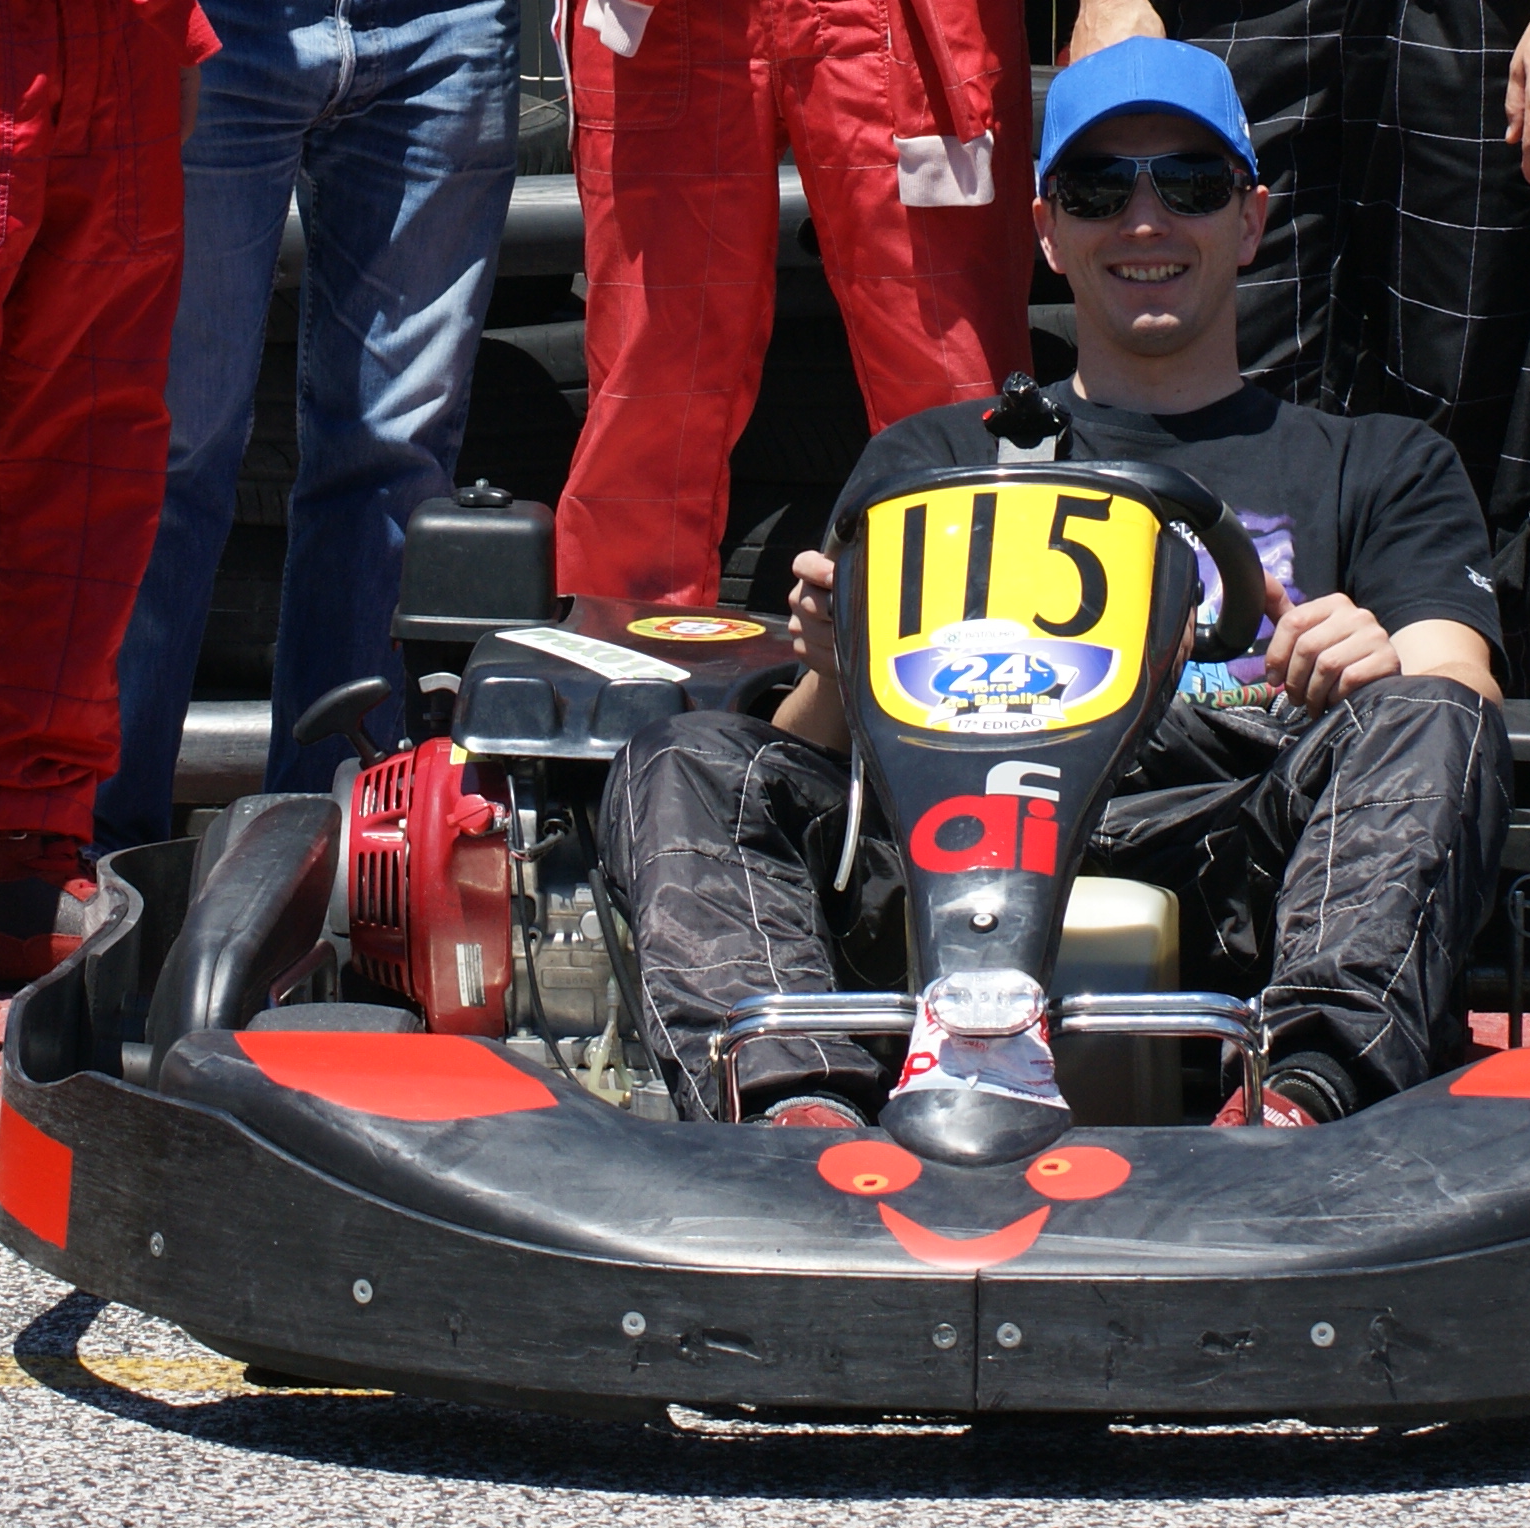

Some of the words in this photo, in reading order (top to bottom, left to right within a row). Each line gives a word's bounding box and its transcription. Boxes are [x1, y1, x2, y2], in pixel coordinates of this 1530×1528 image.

[898, 492, 1114, 640] 115
[949, 654, 1031, 692] 24
[945, 696, 969, 709] da
[974, 692, 1051, 707] Batalha
[982, 716, 1043, 730] EDIÇÃO
